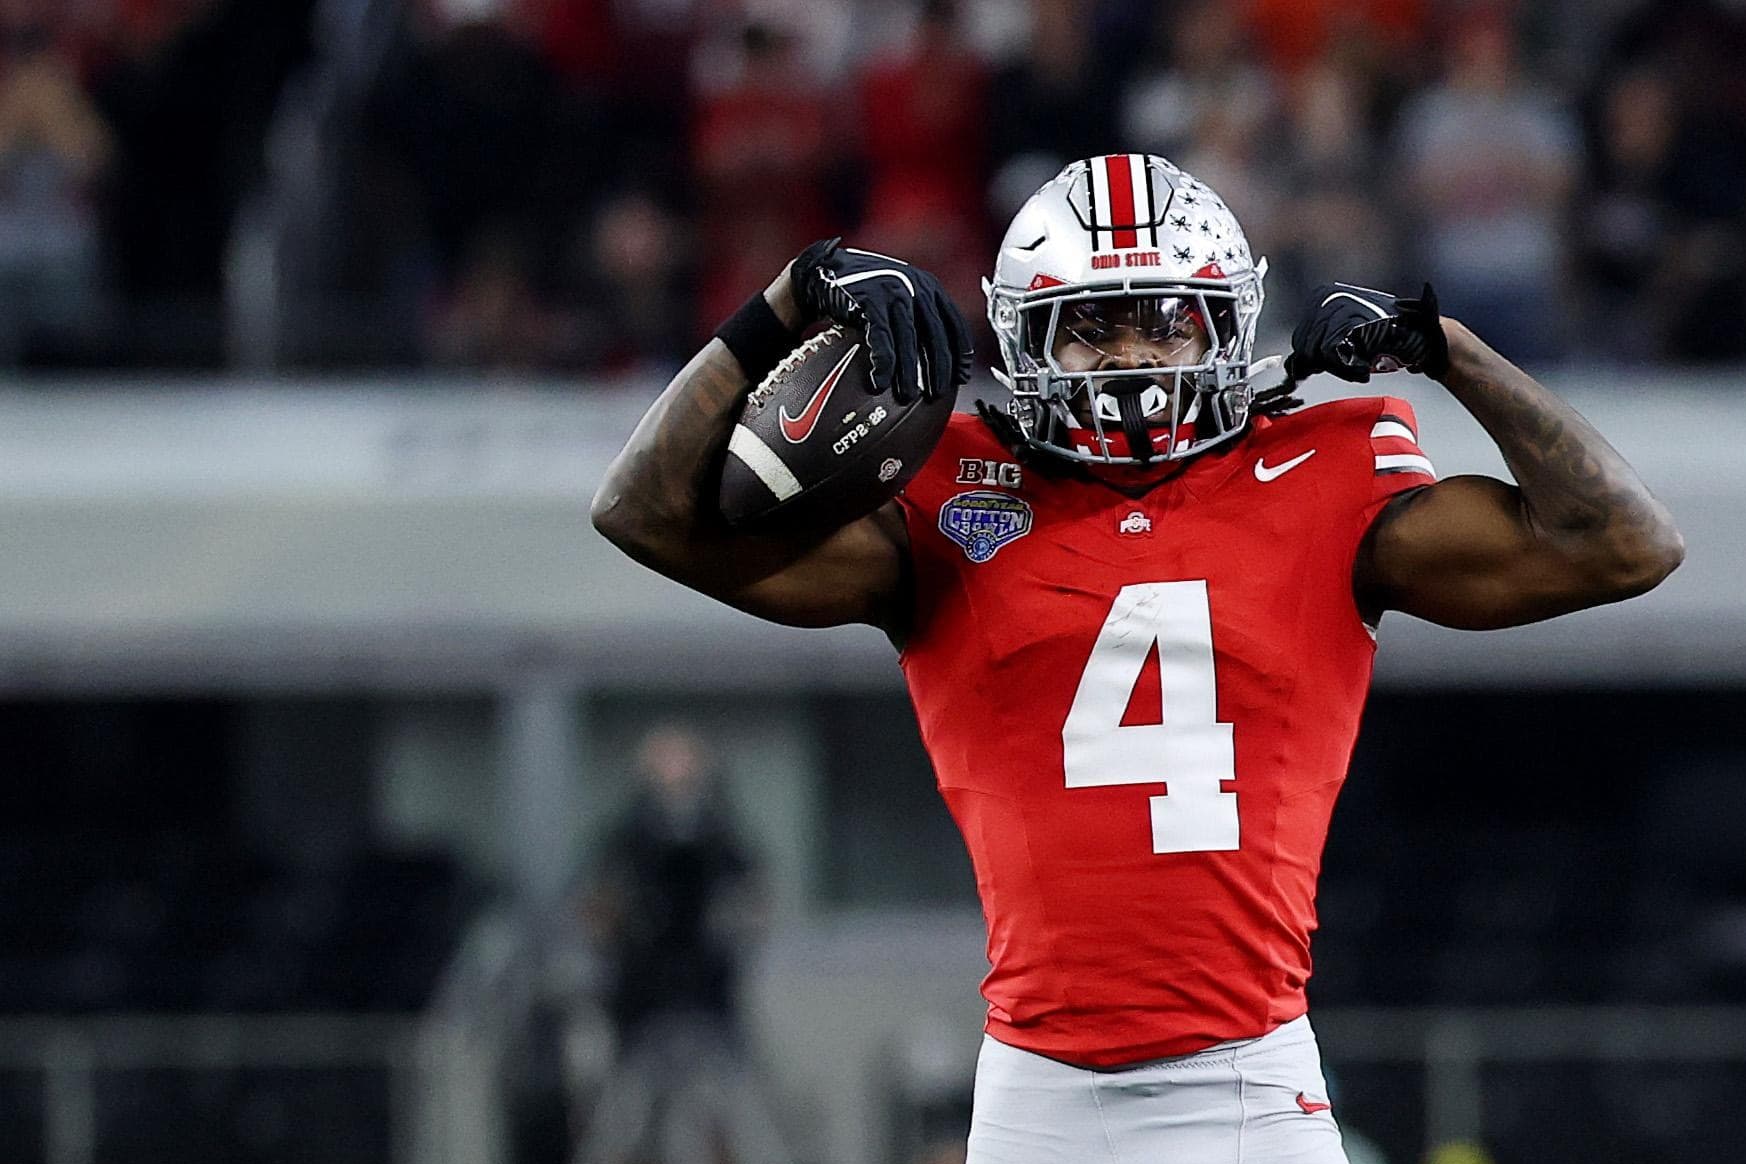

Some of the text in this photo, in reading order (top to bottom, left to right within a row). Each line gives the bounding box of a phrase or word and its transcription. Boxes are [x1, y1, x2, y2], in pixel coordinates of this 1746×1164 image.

[1091, 252, 1161, 270] OHIO STATE
[832, 405, 887, 455] CFP226
[947, 507, 1025, 533] COTTON
[1061, 579, 1241, 855] 4
